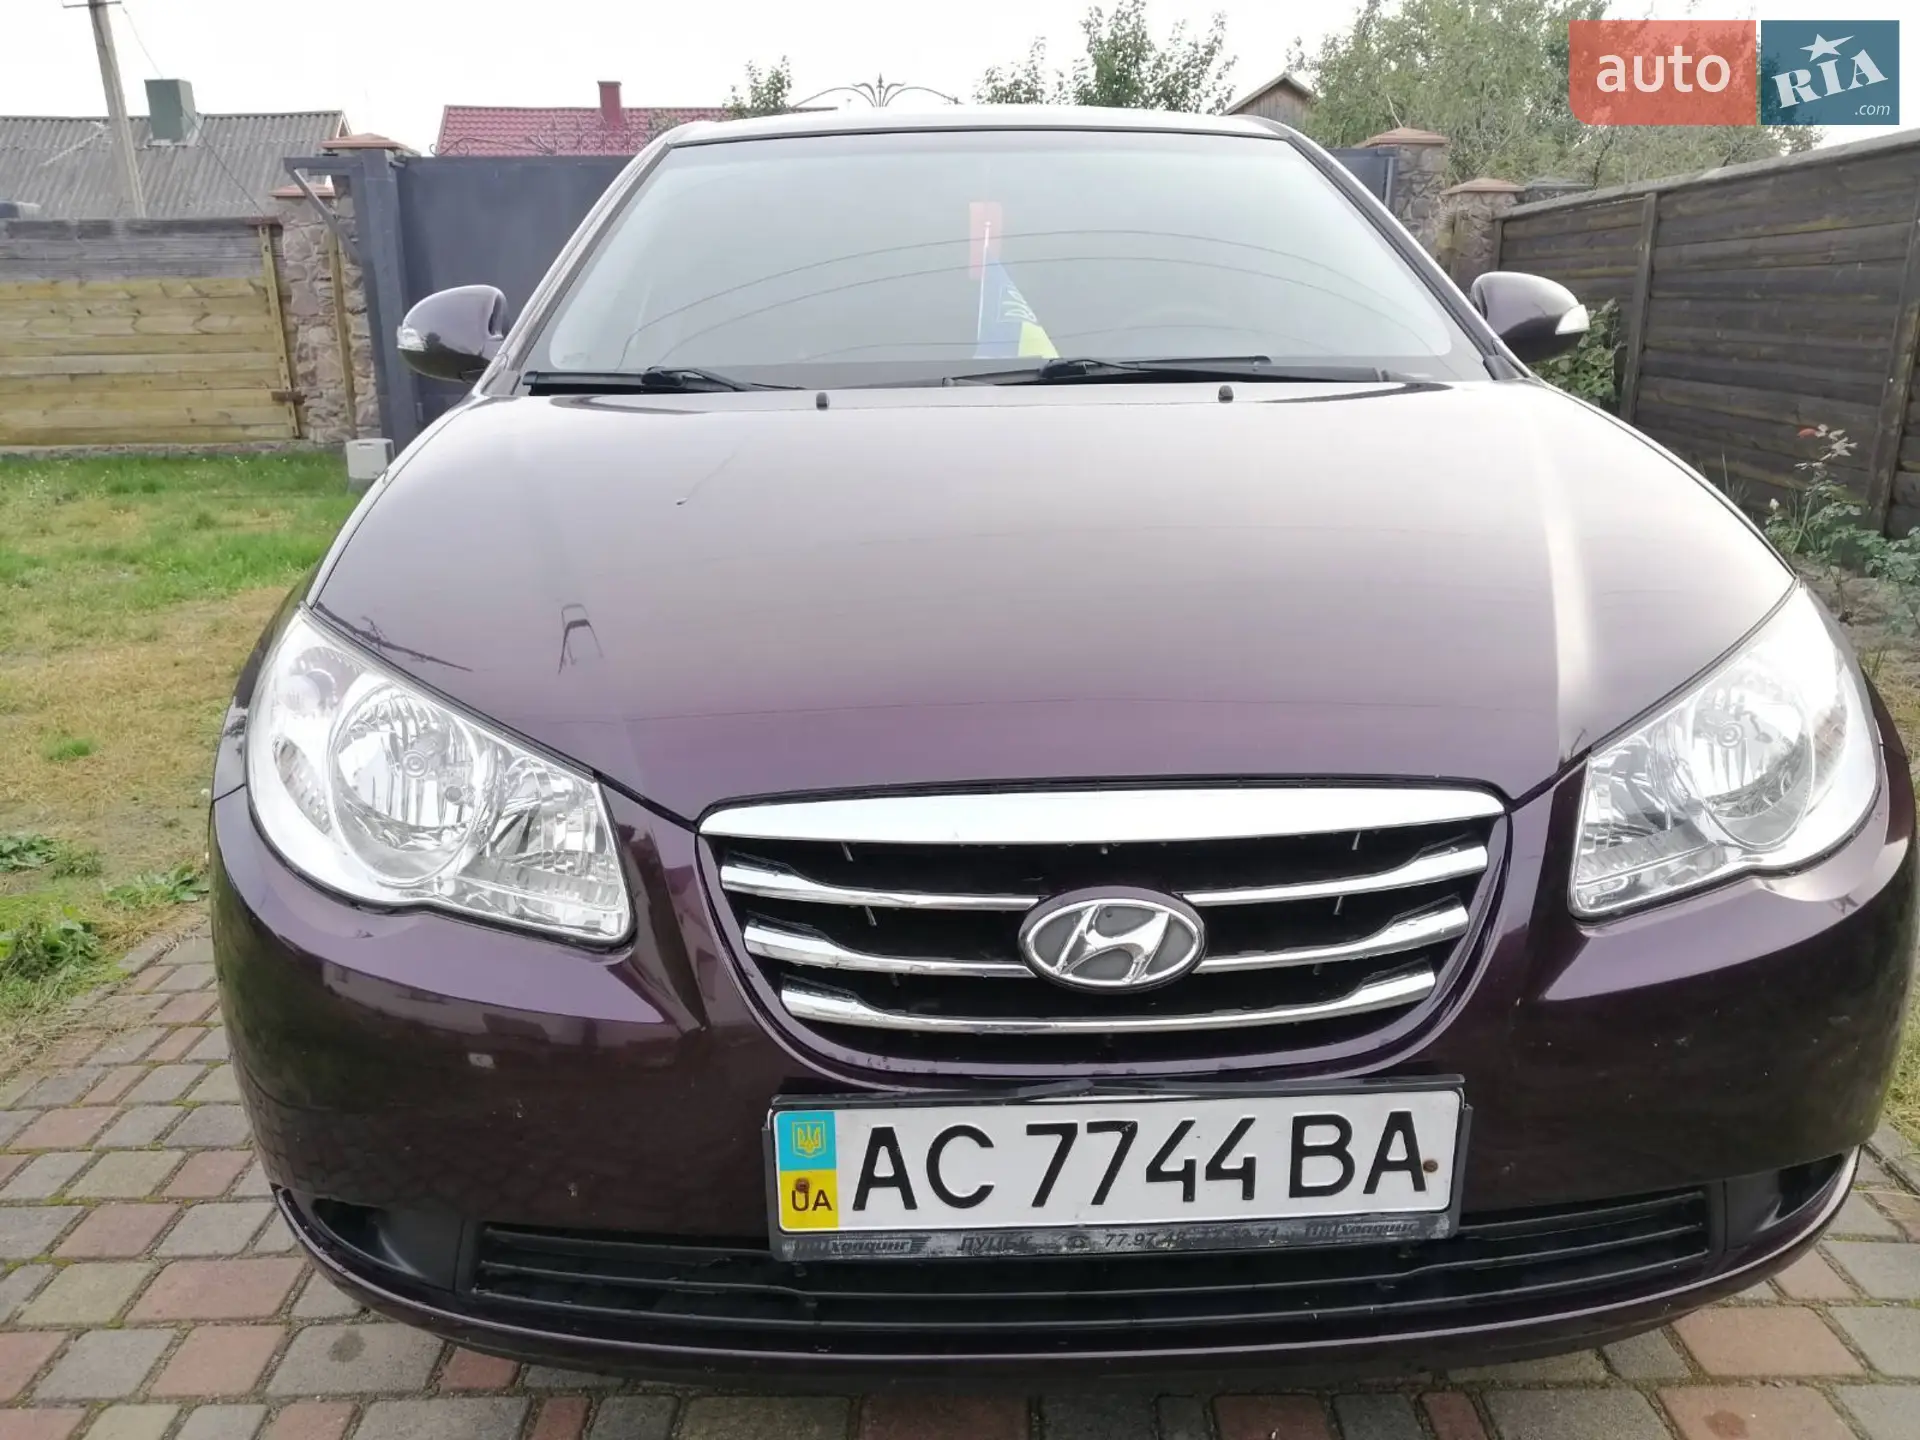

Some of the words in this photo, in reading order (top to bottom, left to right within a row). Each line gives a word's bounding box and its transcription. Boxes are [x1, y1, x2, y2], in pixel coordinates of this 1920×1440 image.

[852, 1124, 995, 1211] AC
[1026, 1116, 1256, 1208] 7744
[1289, 1110, 1427, 1198] BA
[791, 1188, 833, 1212] UA
